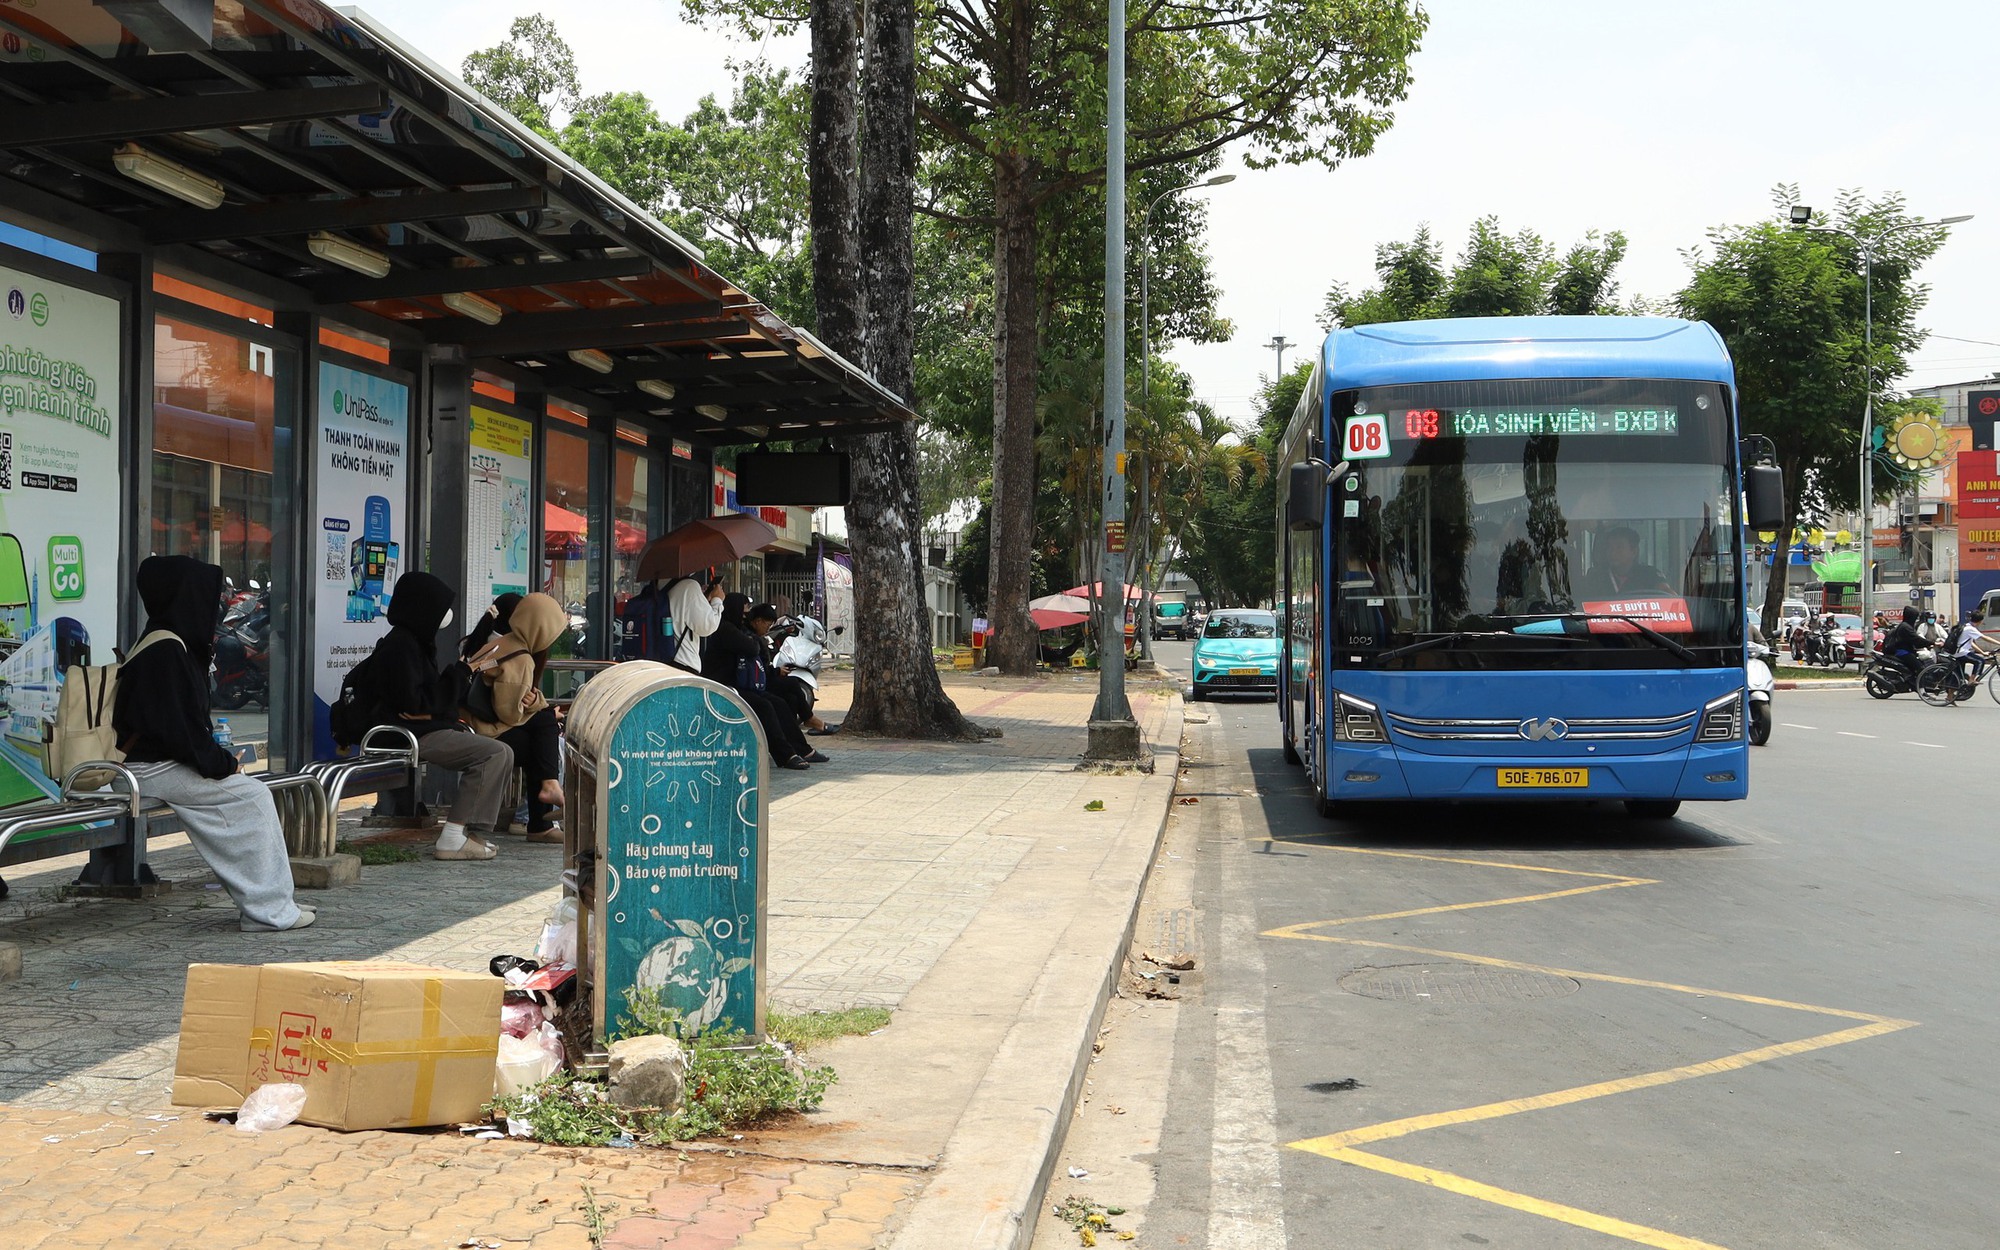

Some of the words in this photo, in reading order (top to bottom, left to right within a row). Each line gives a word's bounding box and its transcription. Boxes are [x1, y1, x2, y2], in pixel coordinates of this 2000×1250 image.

[64, 362, 95, 397] tiện
[29, 383, 70, 418] hành
[74, 397, 110, 435] trình
[344, 393, 379, 422] UniPass
[1405, 409, 1439, 439] 08
[1495, 412, 1544, 434] SINH
[1548, 407, 1596, 433] VIÊN
[1614, 410, 1658, 432] BXB
[325, 428, 351, 447] THANH
[352, 433, 374, 451] TOÁN
[375, 439, 400, 457] NHANH
[1349, 422, 1381, 451] 08
[331, 451, 360, 472] KHÔNG
[379, 461, 394, 481] MẶT
[29, 478, 37, 486] App
[37, 479, 48, 487] Store
[58, 481, 68, 490] Google
[1966, 481, 1987, 491] ANH
[1990, 480, 2000, 490] N
[54, 547, 78, 562] Multi
[53, 565, 80, 592] Go
[1610, 603, 1622, 612] XE
[1624, 601, 1648, 611] BUÝT
[1680, 612, 1686, 621] 8
[1349, 636, 1373, 645] 1005
[621, 750, 630, 758] Vì
[632, 751, 648, 759] một
[666, 750, 683, 760] giới
[685, 750, 712, 759] không
[730, 749, 746, 757] thải
[1505, 771, 1580, 784] 50E-786.07
[626, 843, 649, 859] Hãy
[652, 843, 689, 859] chung
[692, 841, 713, 858] tay
[626, 864, 649, 879] Bảo
[652, 865, 666, 879] vệ
[669, 864, 691, 878] môi
[694, 863, 738, 879] trường
